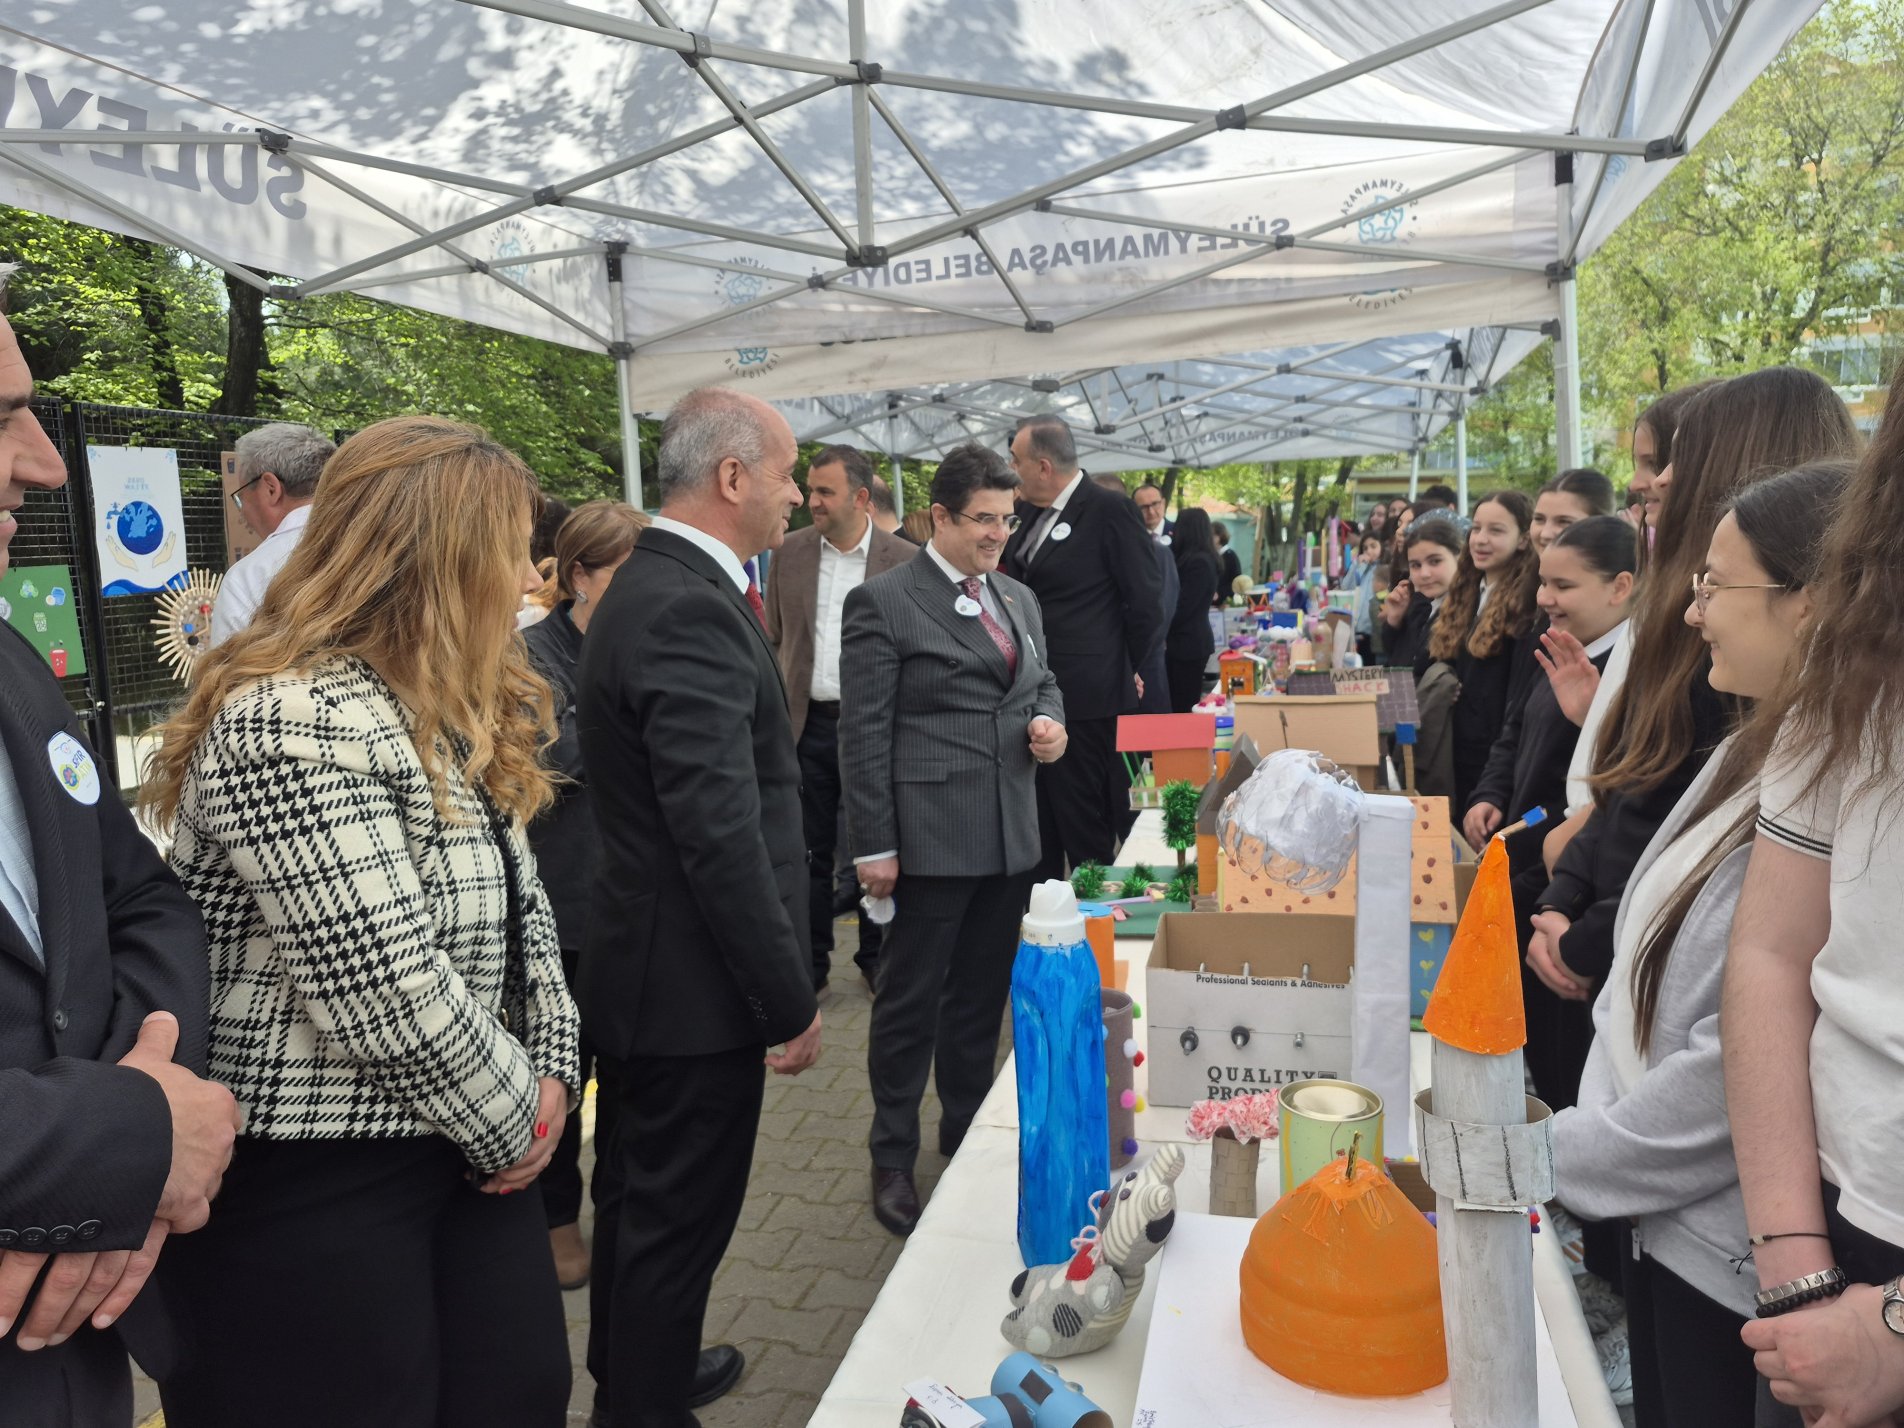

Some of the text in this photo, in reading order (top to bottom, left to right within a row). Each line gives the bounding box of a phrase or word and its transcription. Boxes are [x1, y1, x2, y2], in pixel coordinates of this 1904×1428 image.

[1332, 668, 1383, 683] MYSTERY
[1196, 974, 1248, 985] Professional
[1207, 1066, 1316, 1084] QUALITY
